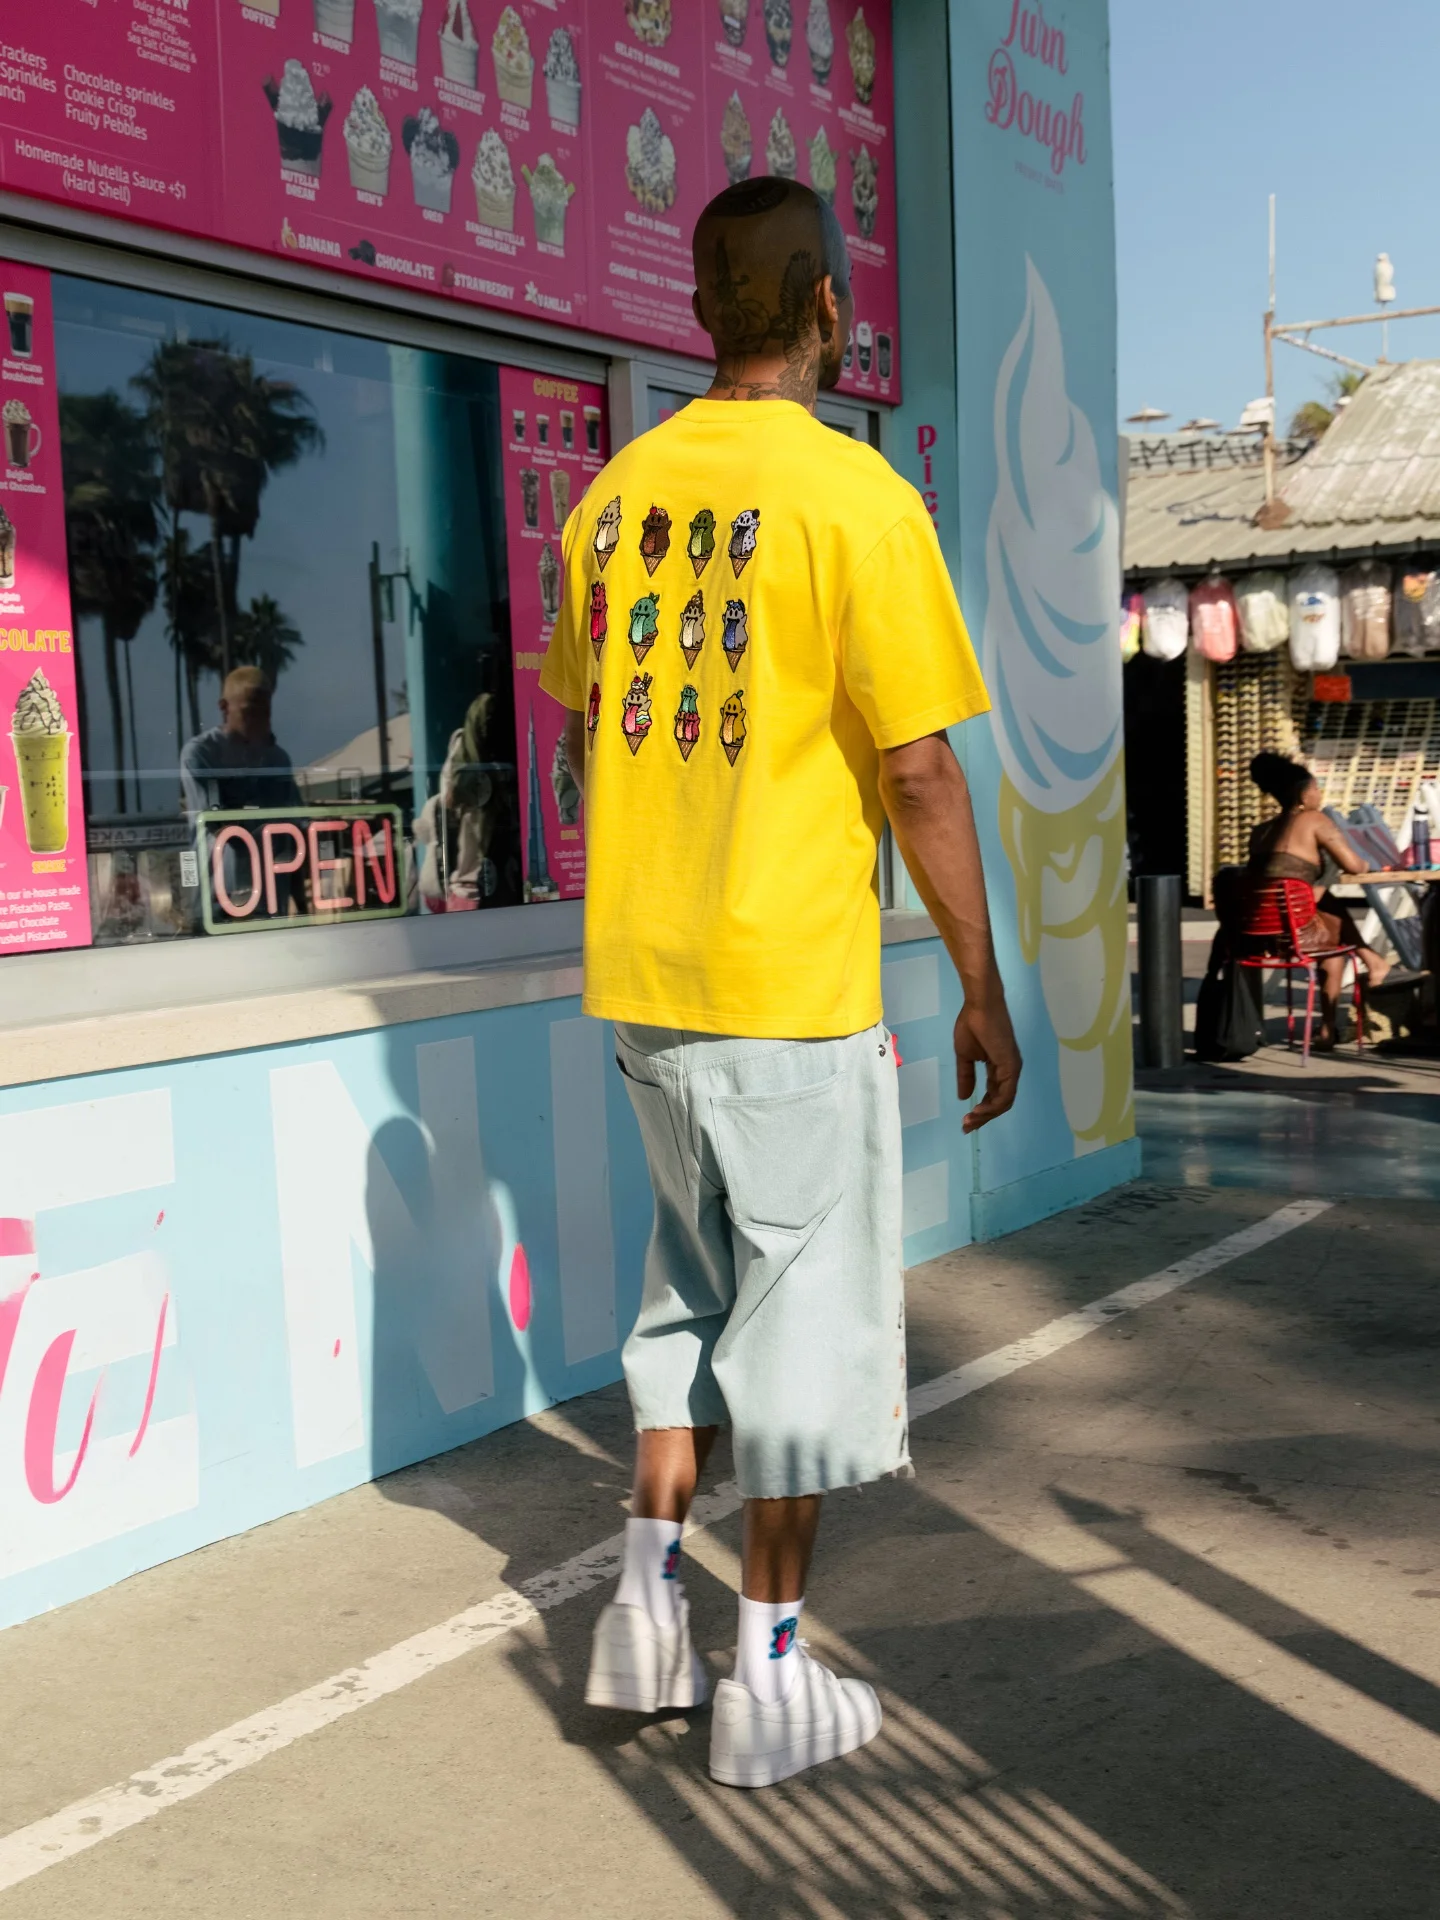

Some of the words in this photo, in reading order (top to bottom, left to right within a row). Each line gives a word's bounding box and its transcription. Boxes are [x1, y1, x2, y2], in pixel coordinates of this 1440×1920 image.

[131, 21, 161, 39] Graham
[242, 7, 276, 29] COFFEE
[127, 31, 142, 45] Sea
[160, 42, 190, 60] Caramel
[136, 46, 168, 65] Caramel
[169, 56, 191, 73] Sauce
[0, 61, 57, 93] Sprinkles
[64, 64, 122, 95] Chocolate
[125, 85, 176, 112] sprinkles
[64, 84, 104, 109] Cookie
[107, 95, 136, 119] Crisp
[985, 48, 1087, 175] Dough
[66, 103, 100, 130] Fruity
[103, 114, 148, 140] Pebbles
[15, 139, 84, 171] Homemade
[87, 156, 130, 184] Nutella
[133, 171, 166, 194] Sauce
[168, 183, 186, 199] +$1
[280, 168, 320, 190] NUTELLA
[63, 170, 95, 193] (Hard
[98, 182, 131, 206] Shell)
[299, 233, 341, 258] BANANA
[376, 252, 435, 281] CHOCOLATE
[454, 273, 514, 300] STRAWBERRY
[538, 293, 572, 314] VANILLA
[533, 377, 579, 403] COFFEE
[212, 817, 396, 918] OPEN
[6, 891, 20, 900] our
[22, 888, 58, 899] in-house
[59, 885, 81, 896] made
[9, 902, 47, 914] Pistachio
[47, 901, 73, 911] Paste,
[20, 916, 59, 928] Chocolate
[0, 932, 26, 944] ushed
[27, 928, 68, 941] Pistachios
